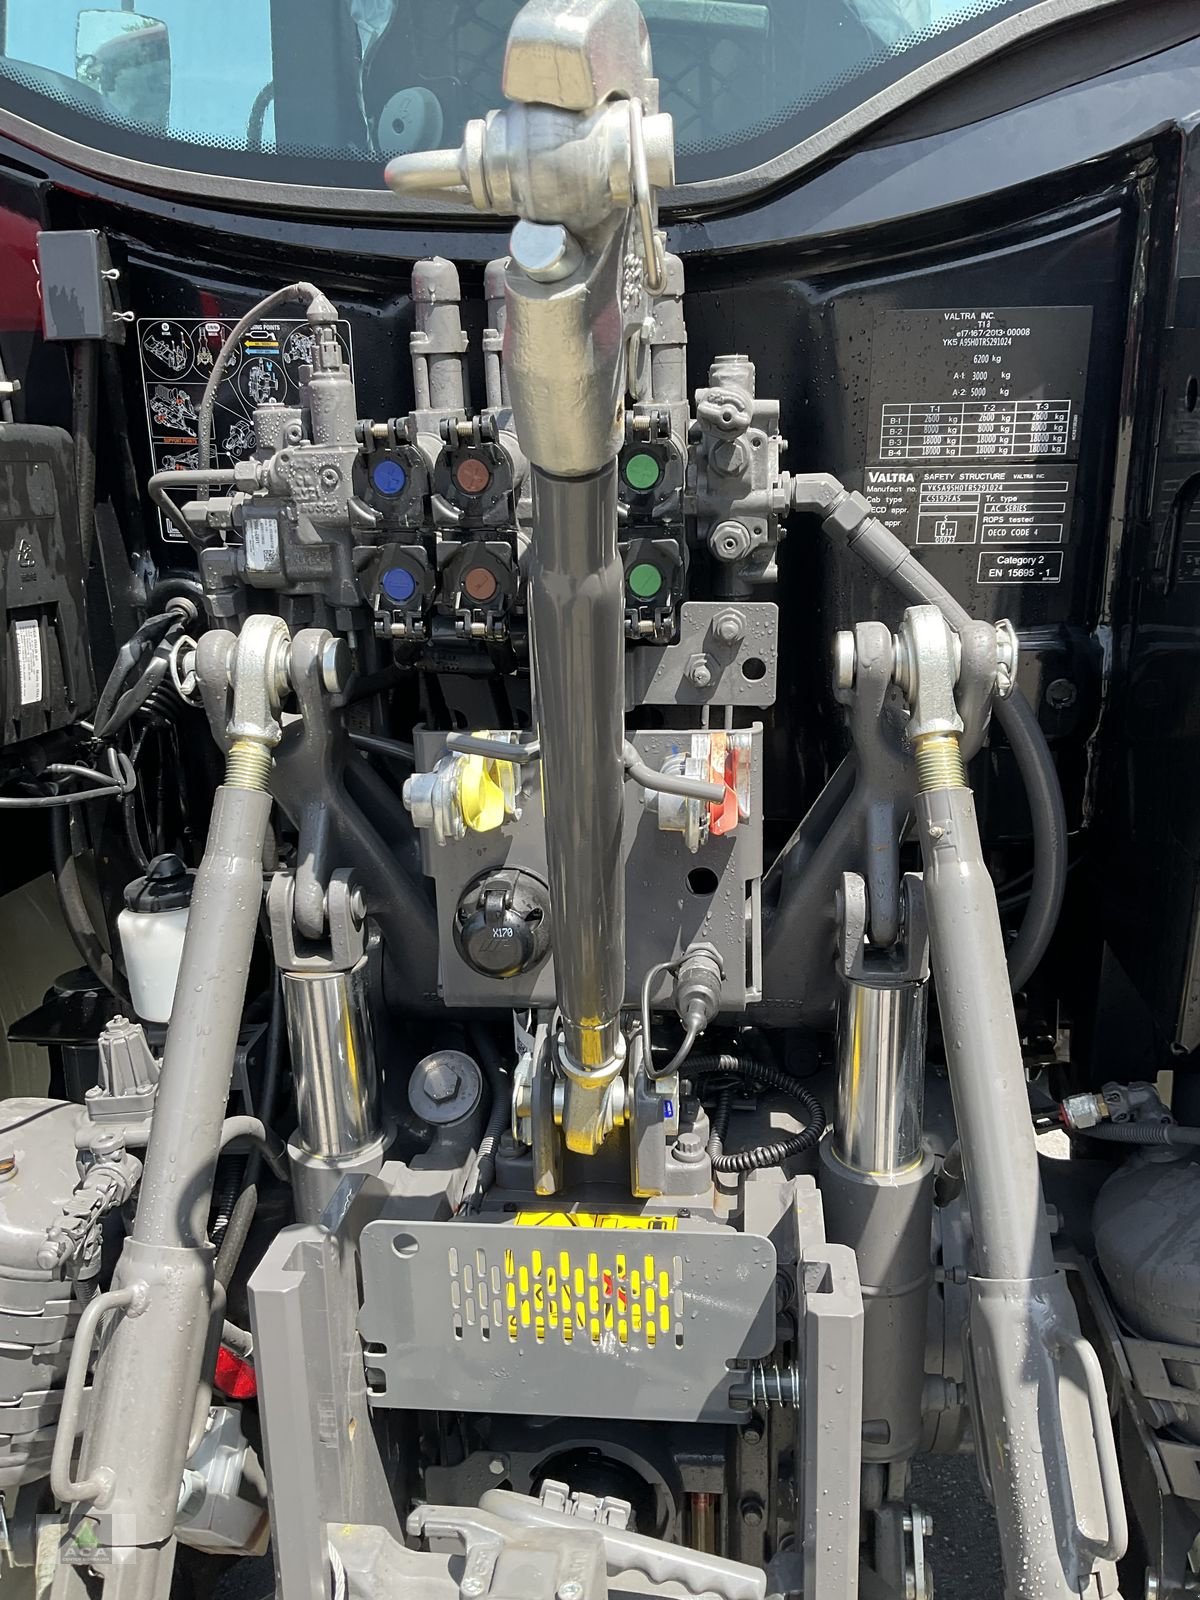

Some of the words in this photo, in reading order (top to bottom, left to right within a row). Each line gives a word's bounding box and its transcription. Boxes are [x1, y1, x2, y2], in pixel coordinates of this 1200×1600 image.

[944, 312, 976, 320] VALTRA
[973, 354, 989, 364] 6200
[992, 355, 1002, 363] kg
[972, 372, 988, 380] 3000
[1001, 372, 1011, 380] kg
[970, 388, 986, 396] 5000
[1000, 388, 1010, 396] kg
[869, 472, 914, 482] VALTRA
[997, 556, 1036, 565] Category
[492, 928, 513, 937] X170
